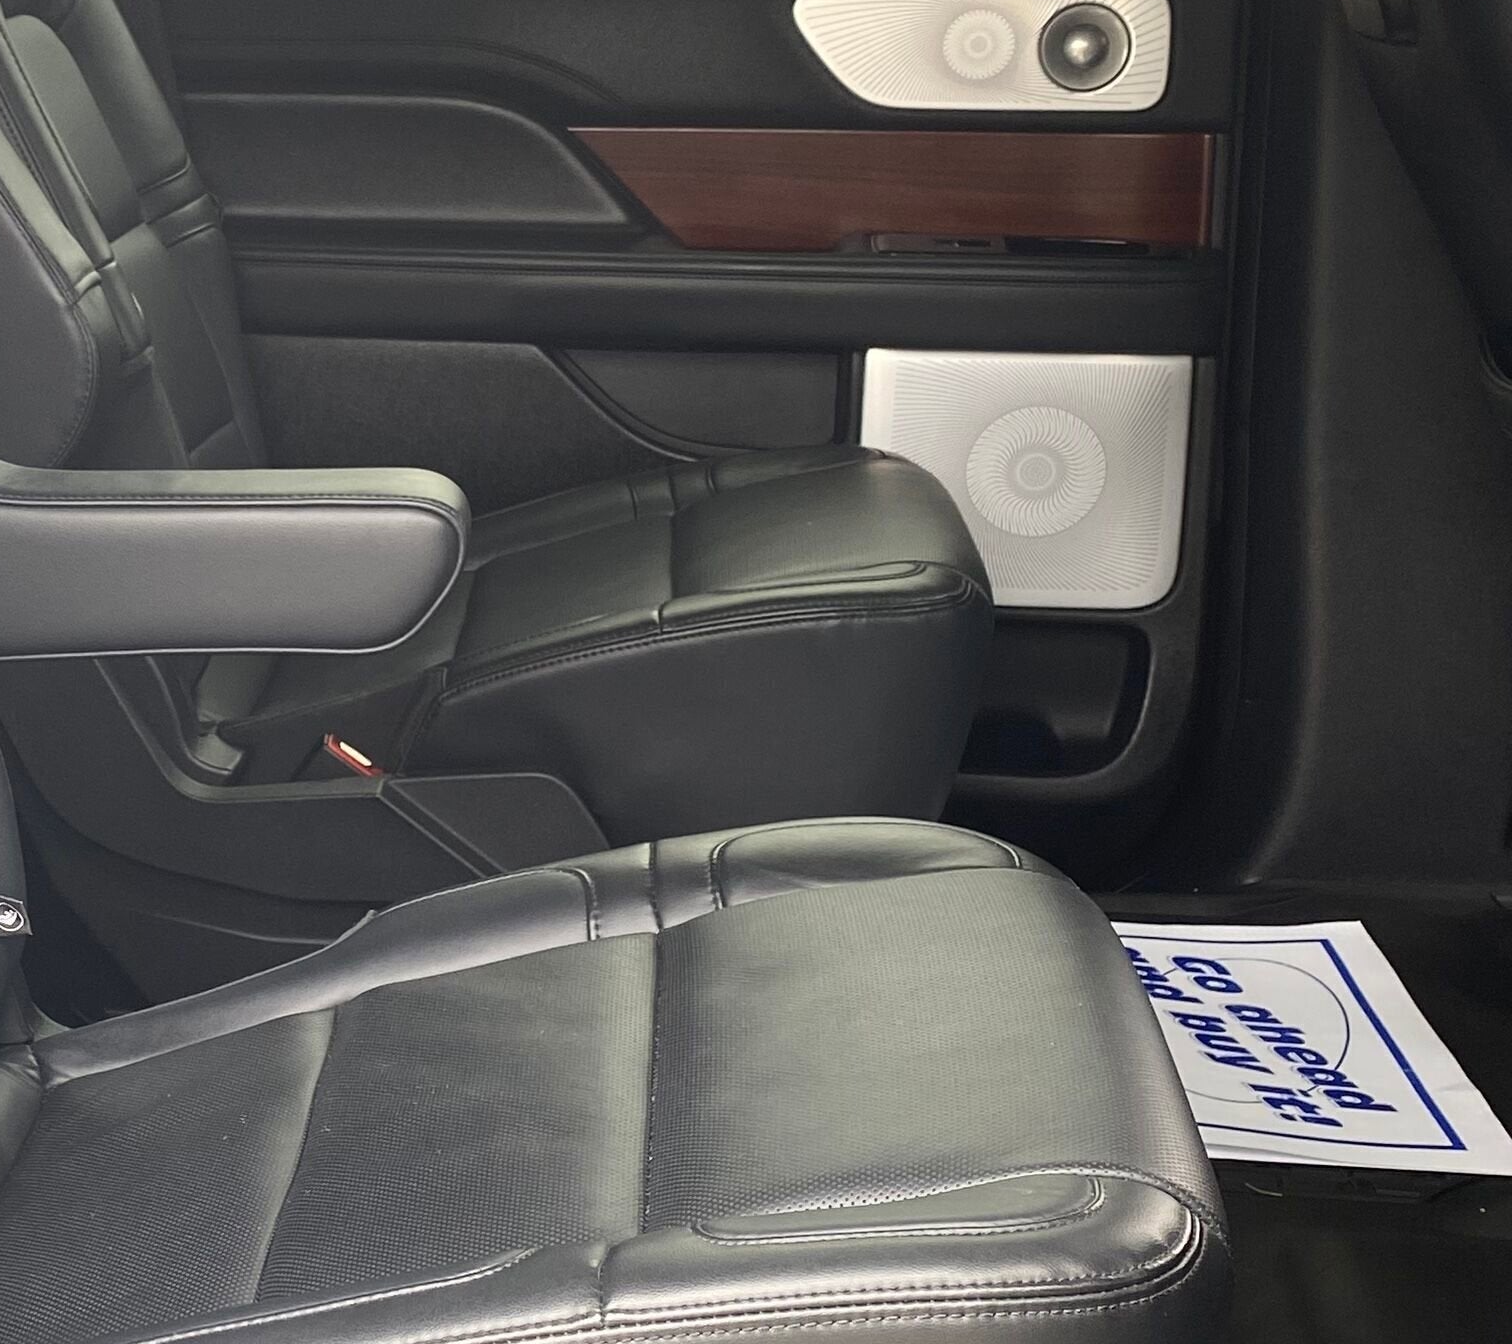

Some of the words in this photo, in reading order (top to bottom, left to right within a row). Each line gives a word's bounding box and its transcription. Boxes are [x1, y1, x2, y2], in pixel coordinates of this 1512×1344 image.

[1166, 1009, 1275, 1076] buy
[1246, 1082, 1344, 1128] it!
[1168, 954, 1244, 994] Go
[1223, 1003, 1399, 1113] ahead
